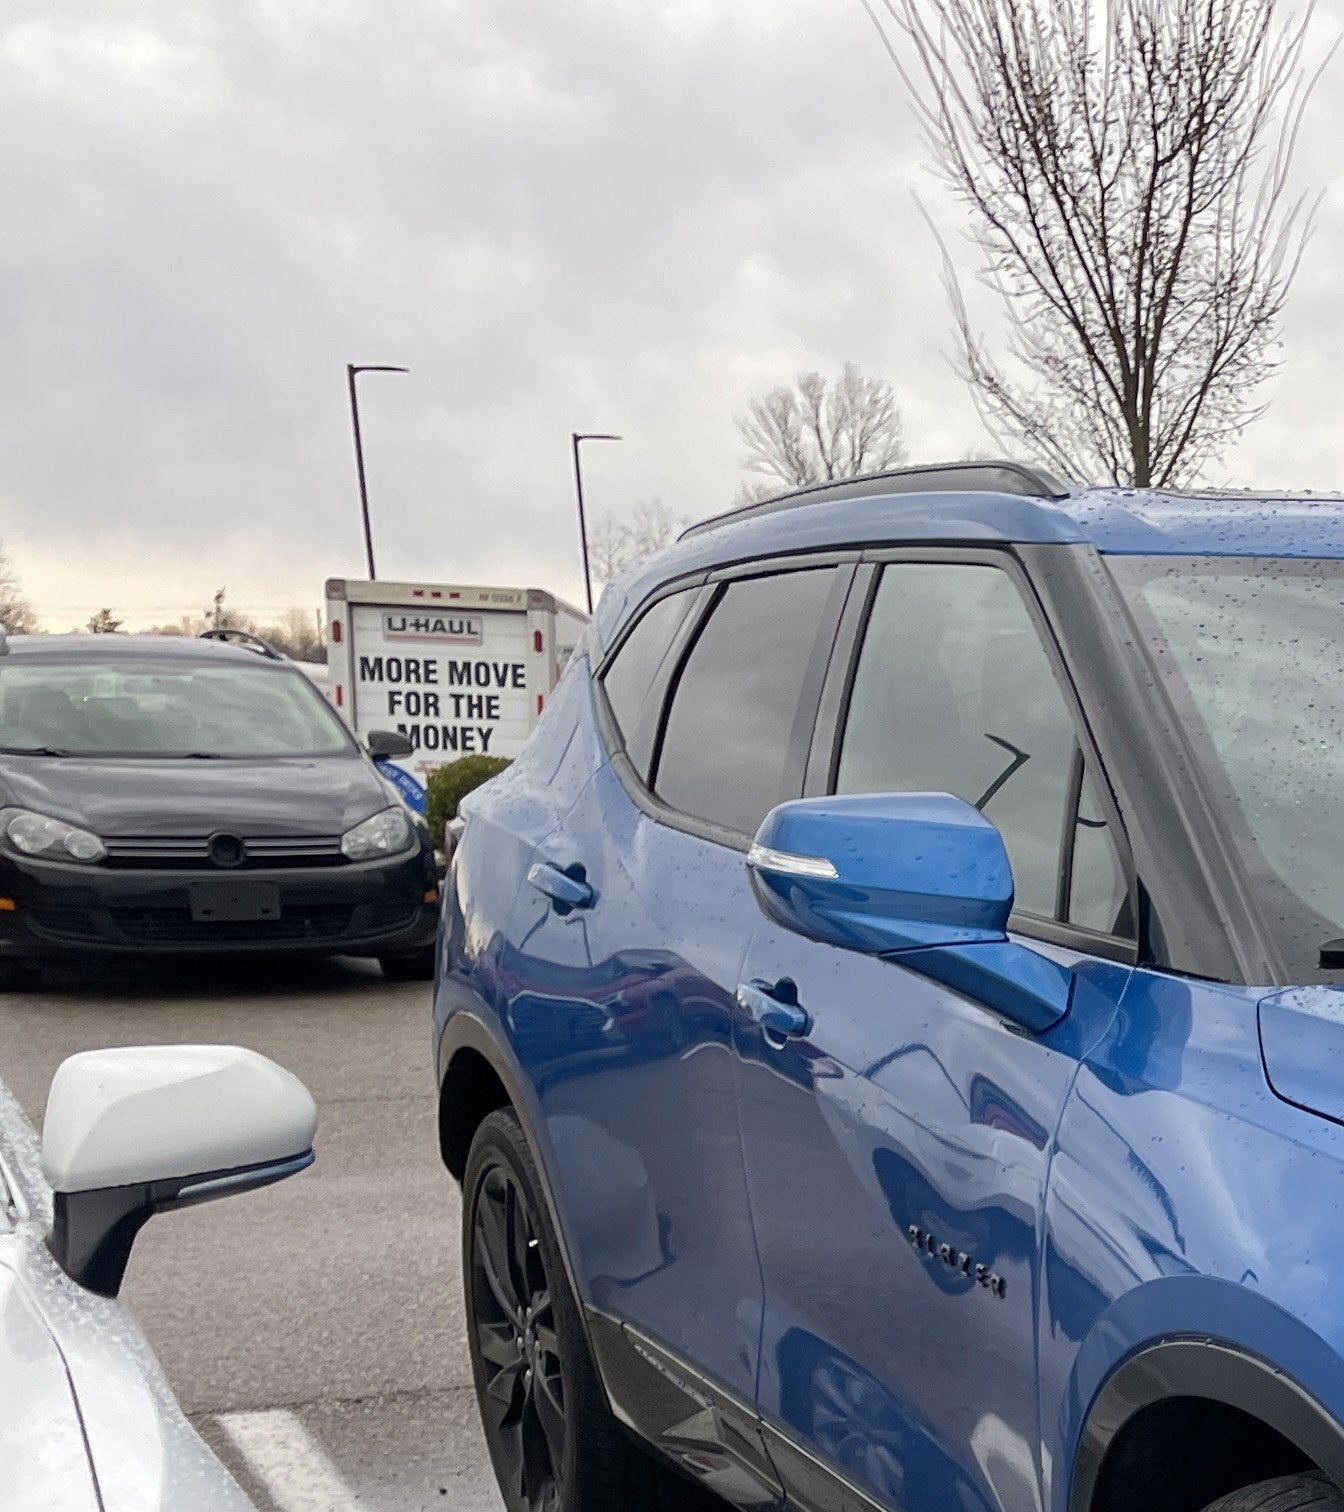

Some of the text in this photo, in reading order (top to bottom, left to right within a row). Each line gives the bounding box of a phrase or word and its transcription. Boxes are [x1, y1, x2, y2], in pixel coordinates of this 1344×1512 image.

[386, 616, 480, 635] U-HAUL
[359, 656, 526, 688] MORE MOVE
[388, 690, 500, 719] FOR THE
[397, 724, 494, 752] MONEY
[909, 1224, 1007, 1300] BLAZER
